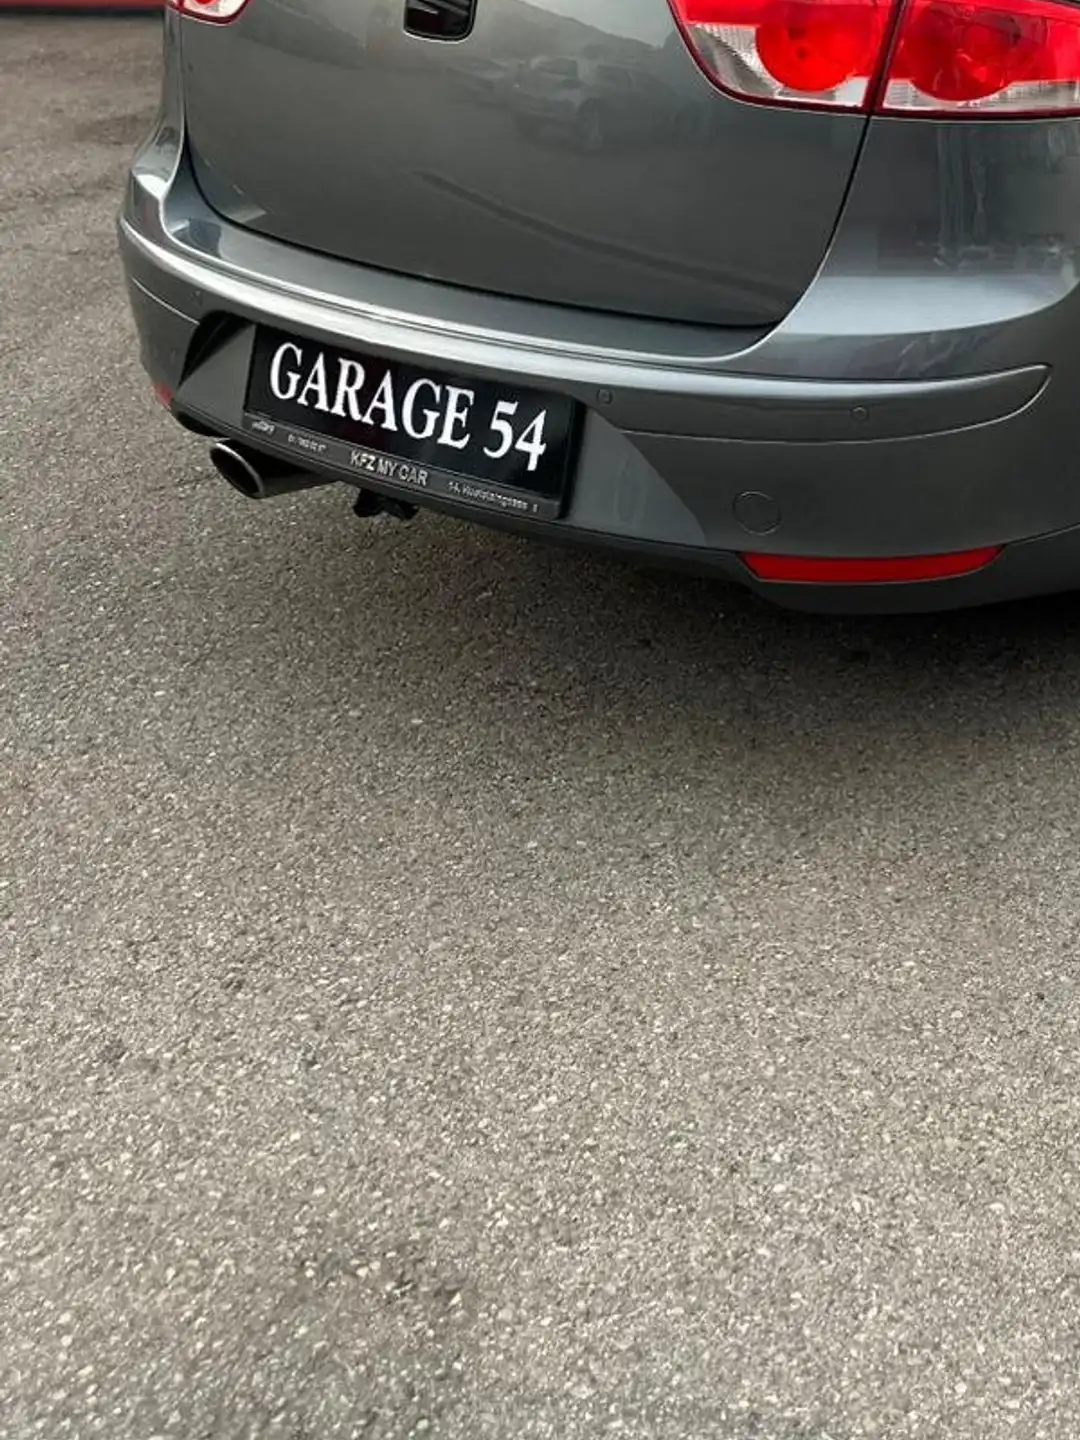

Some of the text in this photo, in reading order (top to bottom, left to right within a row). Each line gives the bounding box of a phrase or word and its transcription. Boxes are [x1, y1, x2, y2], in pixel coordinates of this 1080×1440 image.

[270, 342, 547, 471] GARAGE 54
[350, 450, 428, 487] KFZ MY CAR
